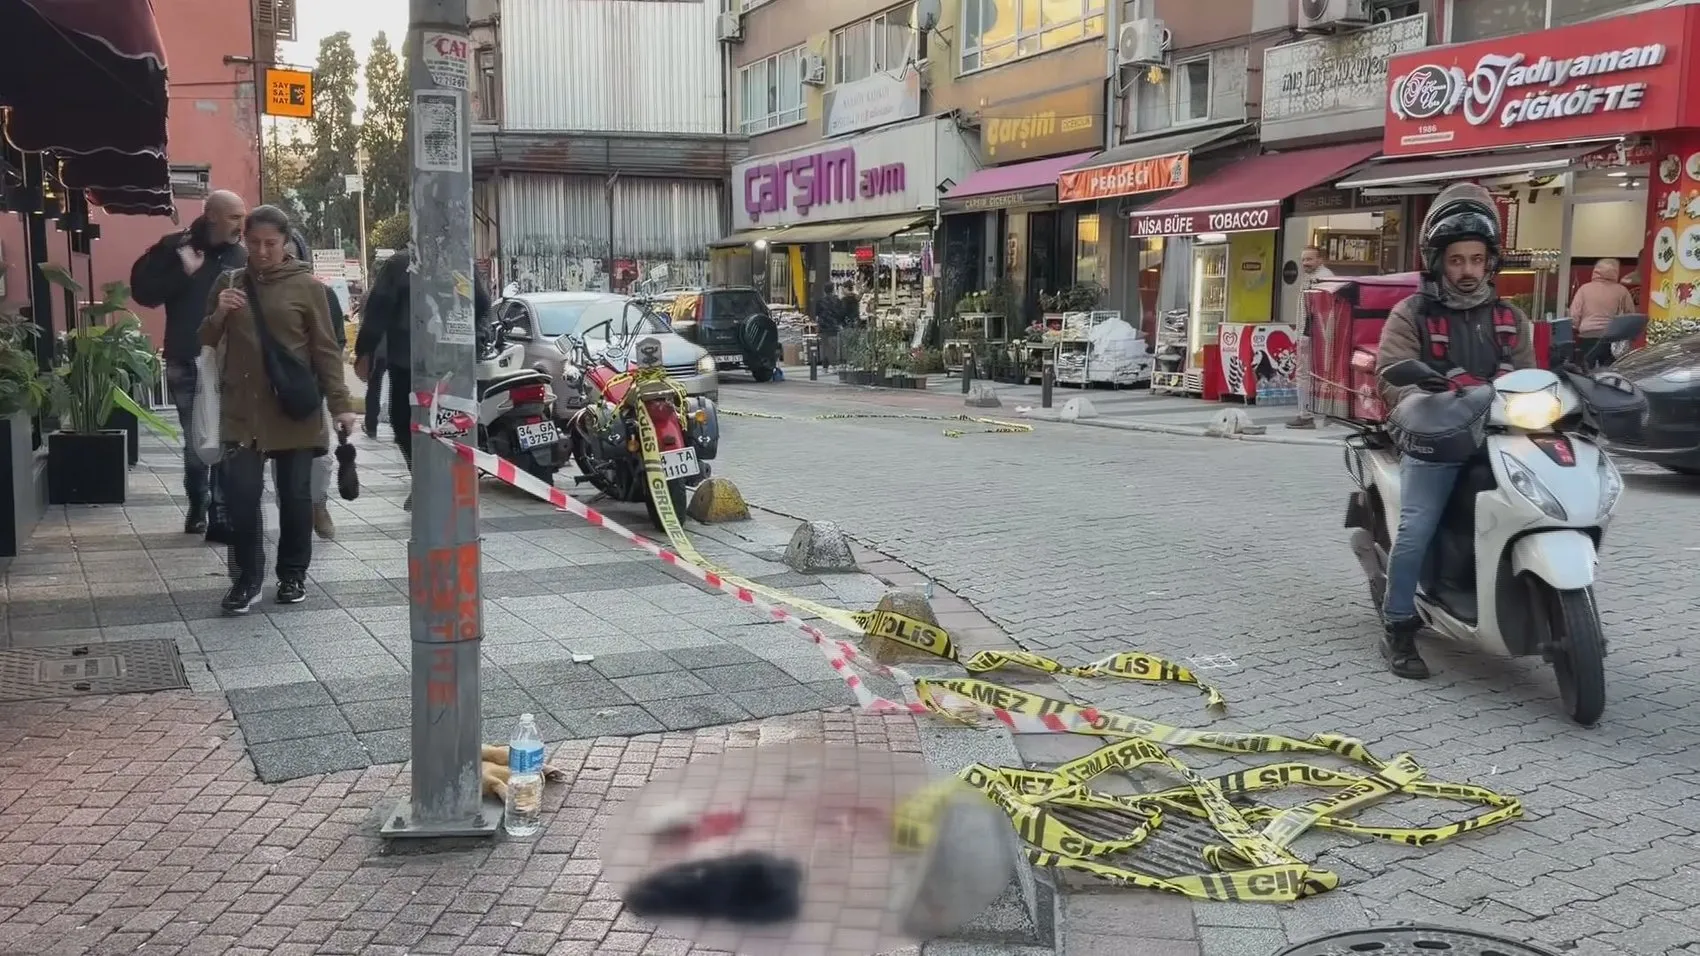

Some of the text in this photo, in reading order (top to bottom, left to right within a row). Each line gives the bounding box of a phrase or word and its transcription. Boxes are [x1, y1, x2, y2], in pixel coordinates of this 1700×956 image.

[1500, 83, 1647, 128] ÇİĞKÖFTE
[860, 162, 905, 198] avm
[1090, 169, 1149, 190] PERDECİ
[1138, 209, 1268, 234] NİSA BÜFE TOBACCO
[519, 423, 555, 437] 34 GA
[529, 431, 554, 445] 3757
[678, 451, 693, 461] TA
